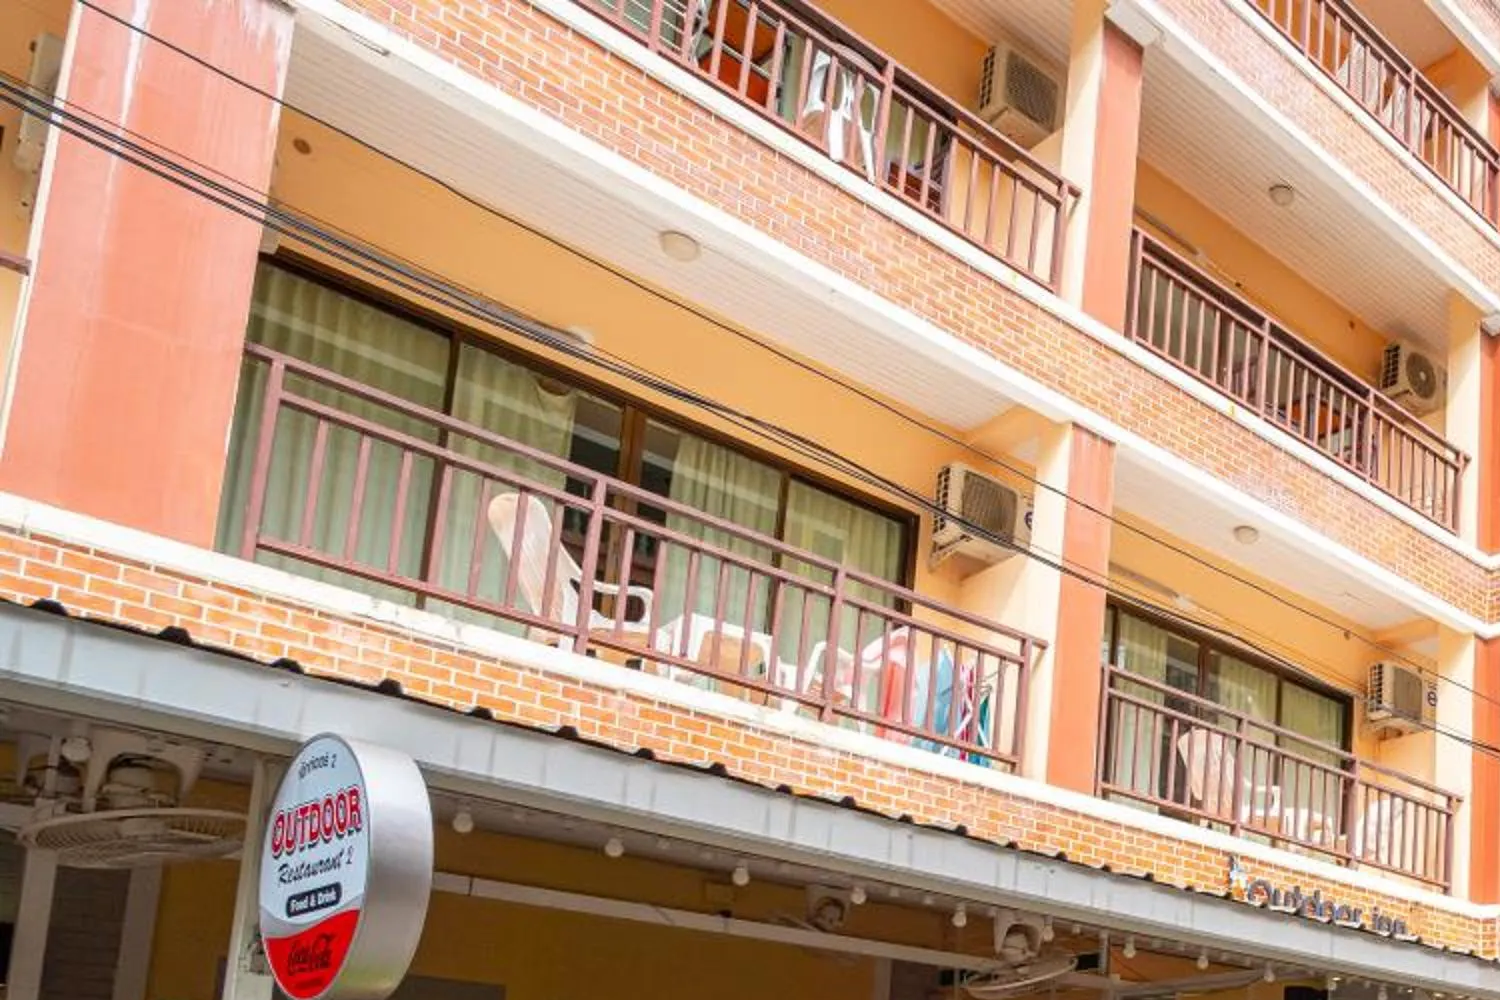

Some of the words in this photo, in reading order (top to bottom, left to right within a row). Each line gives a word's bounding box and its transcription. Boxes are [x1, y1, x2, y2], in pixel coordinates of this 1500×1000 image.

[271, 784, 363, 859] OUTDOOR
[278, 848, 344, 885] Restaurant
[290, 895, 308, 913] Food
[310, 892, 316, 907] &
[317, 887, 337, 905] Drink
